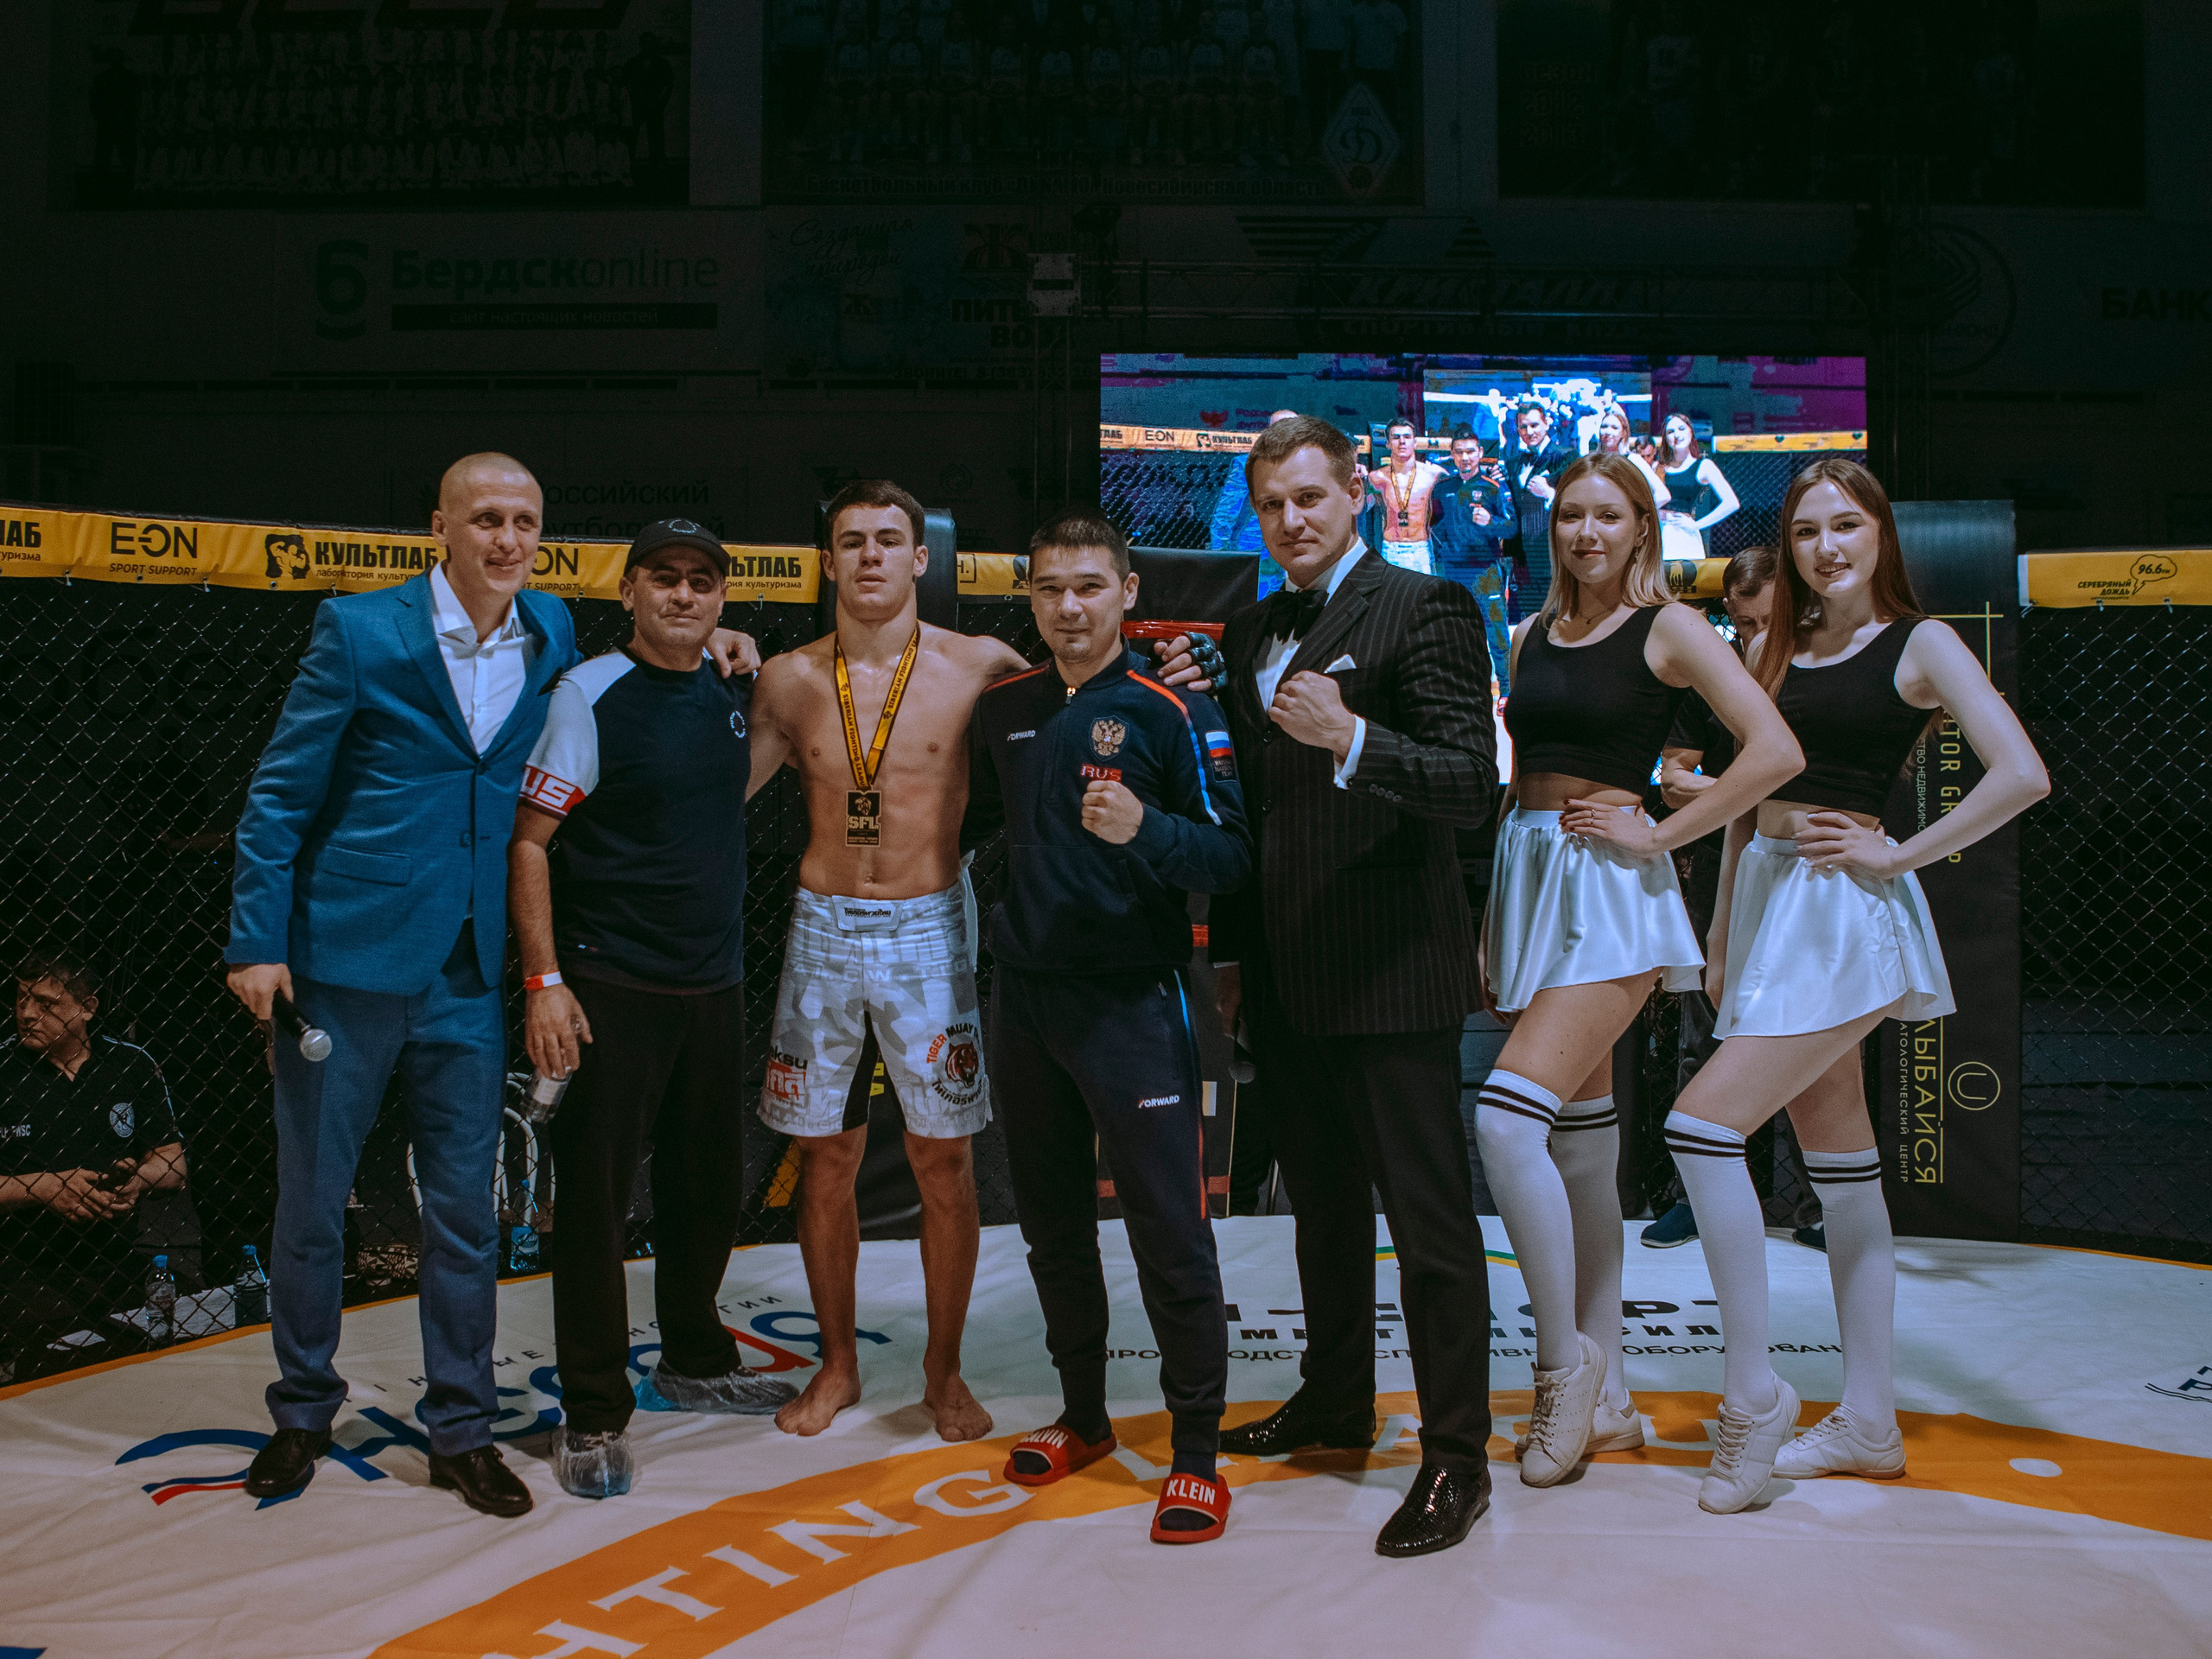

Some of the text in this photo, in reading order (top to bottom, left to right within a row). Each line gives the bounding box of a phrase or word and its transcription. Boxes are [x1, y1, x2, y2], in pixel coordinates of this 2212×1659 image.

[448, 308, 486, 325] сайт
[582, 307, 659, 325] новостей
[110, 521, 199, 559] EON
[0, 551, 41, 562] уризма
[109, 563, 198, 577] SPORT SUPPORT
[315, 541, 438, 571] КУЛЬТЛАБ
[531, 547, 579, 576] ON
[726, 556, 802, 579] ЬТЛАБ
[534, 582, 579, 593] SUPPORT
[745, 580, 802, 590] культуризма
[2077, 578, 2132, 588] СЕРЕБРЯНЫЙ
[887, 679, 903, 709] SIBERIAN
[843, 694, 855, 727] SIBERIAN
[1940, 709, 1961, 772] ITOR
[1080, 764, 1122, 782] RUS
[848, 816, 880, 830] SFL
[926, 1033, 948, 1064] TIGER
[945, 1022, 975, 1039] MUAY
[1899, 1021, 1909, 1183] АТОЛОГИЧЕСКИЙ ЦЕНТР
[1914, 1018, 1941, 1184] ЛЫБАЙСЯ
[1166, 1478, 1216, 1506] KLEIN
[510, 1470, 1040, 1659] HTING
